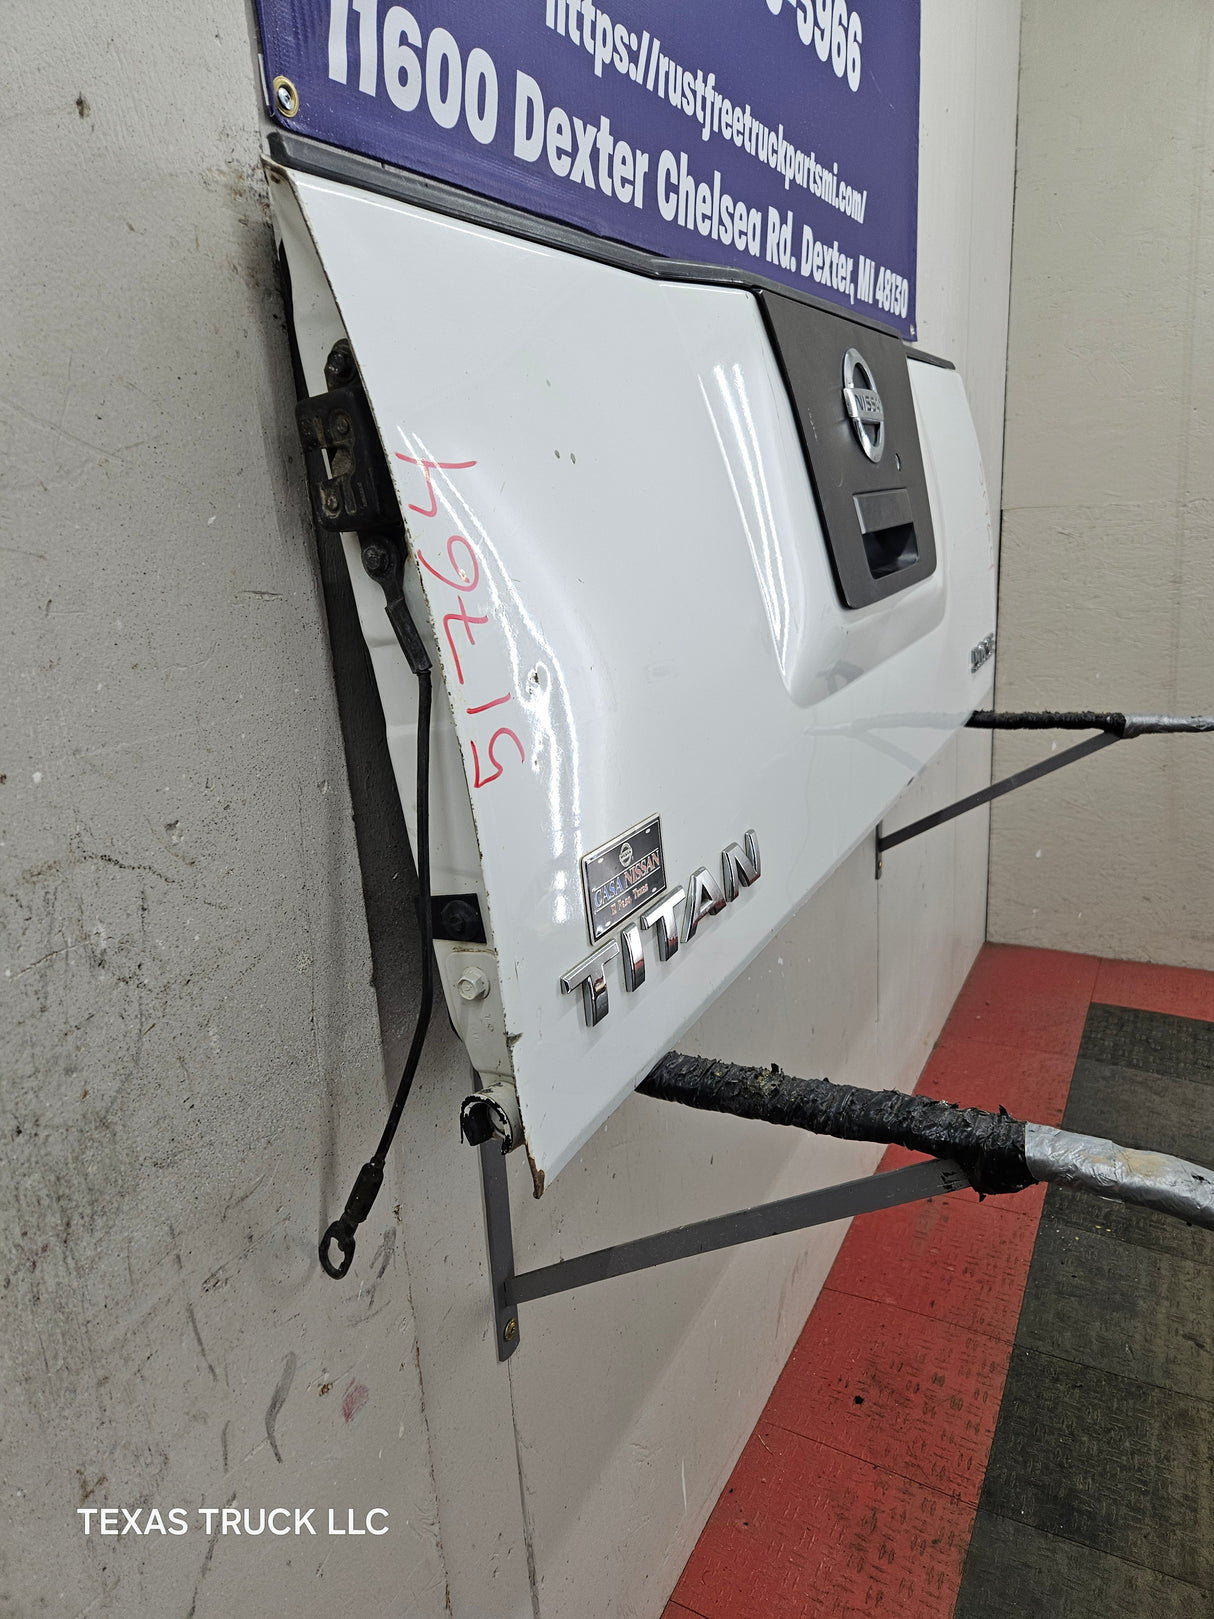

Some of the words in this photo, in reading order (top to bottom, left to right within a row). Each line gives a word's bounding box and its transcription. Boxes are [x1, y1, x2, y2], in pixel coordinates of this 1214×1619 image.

[765, 0, 862, 92] 5966
[328, 0, 499, 144] 11600
[513, 69, 649, 209] Dexter
[657, 150, 762, 256] Chelsea
[766, 206, 797, 273] Rd.
[801, 224, 854, 305] Dexter,
[857, 254, 875, 304] MI
[875, 266, 909, 319] 48130
[395, 452, 525, 788] 51764
[560, 828, 762, 1028] TITAN
[594, 877, 625, 908] CASA
[624, 850, 660, 889] NISSAN
